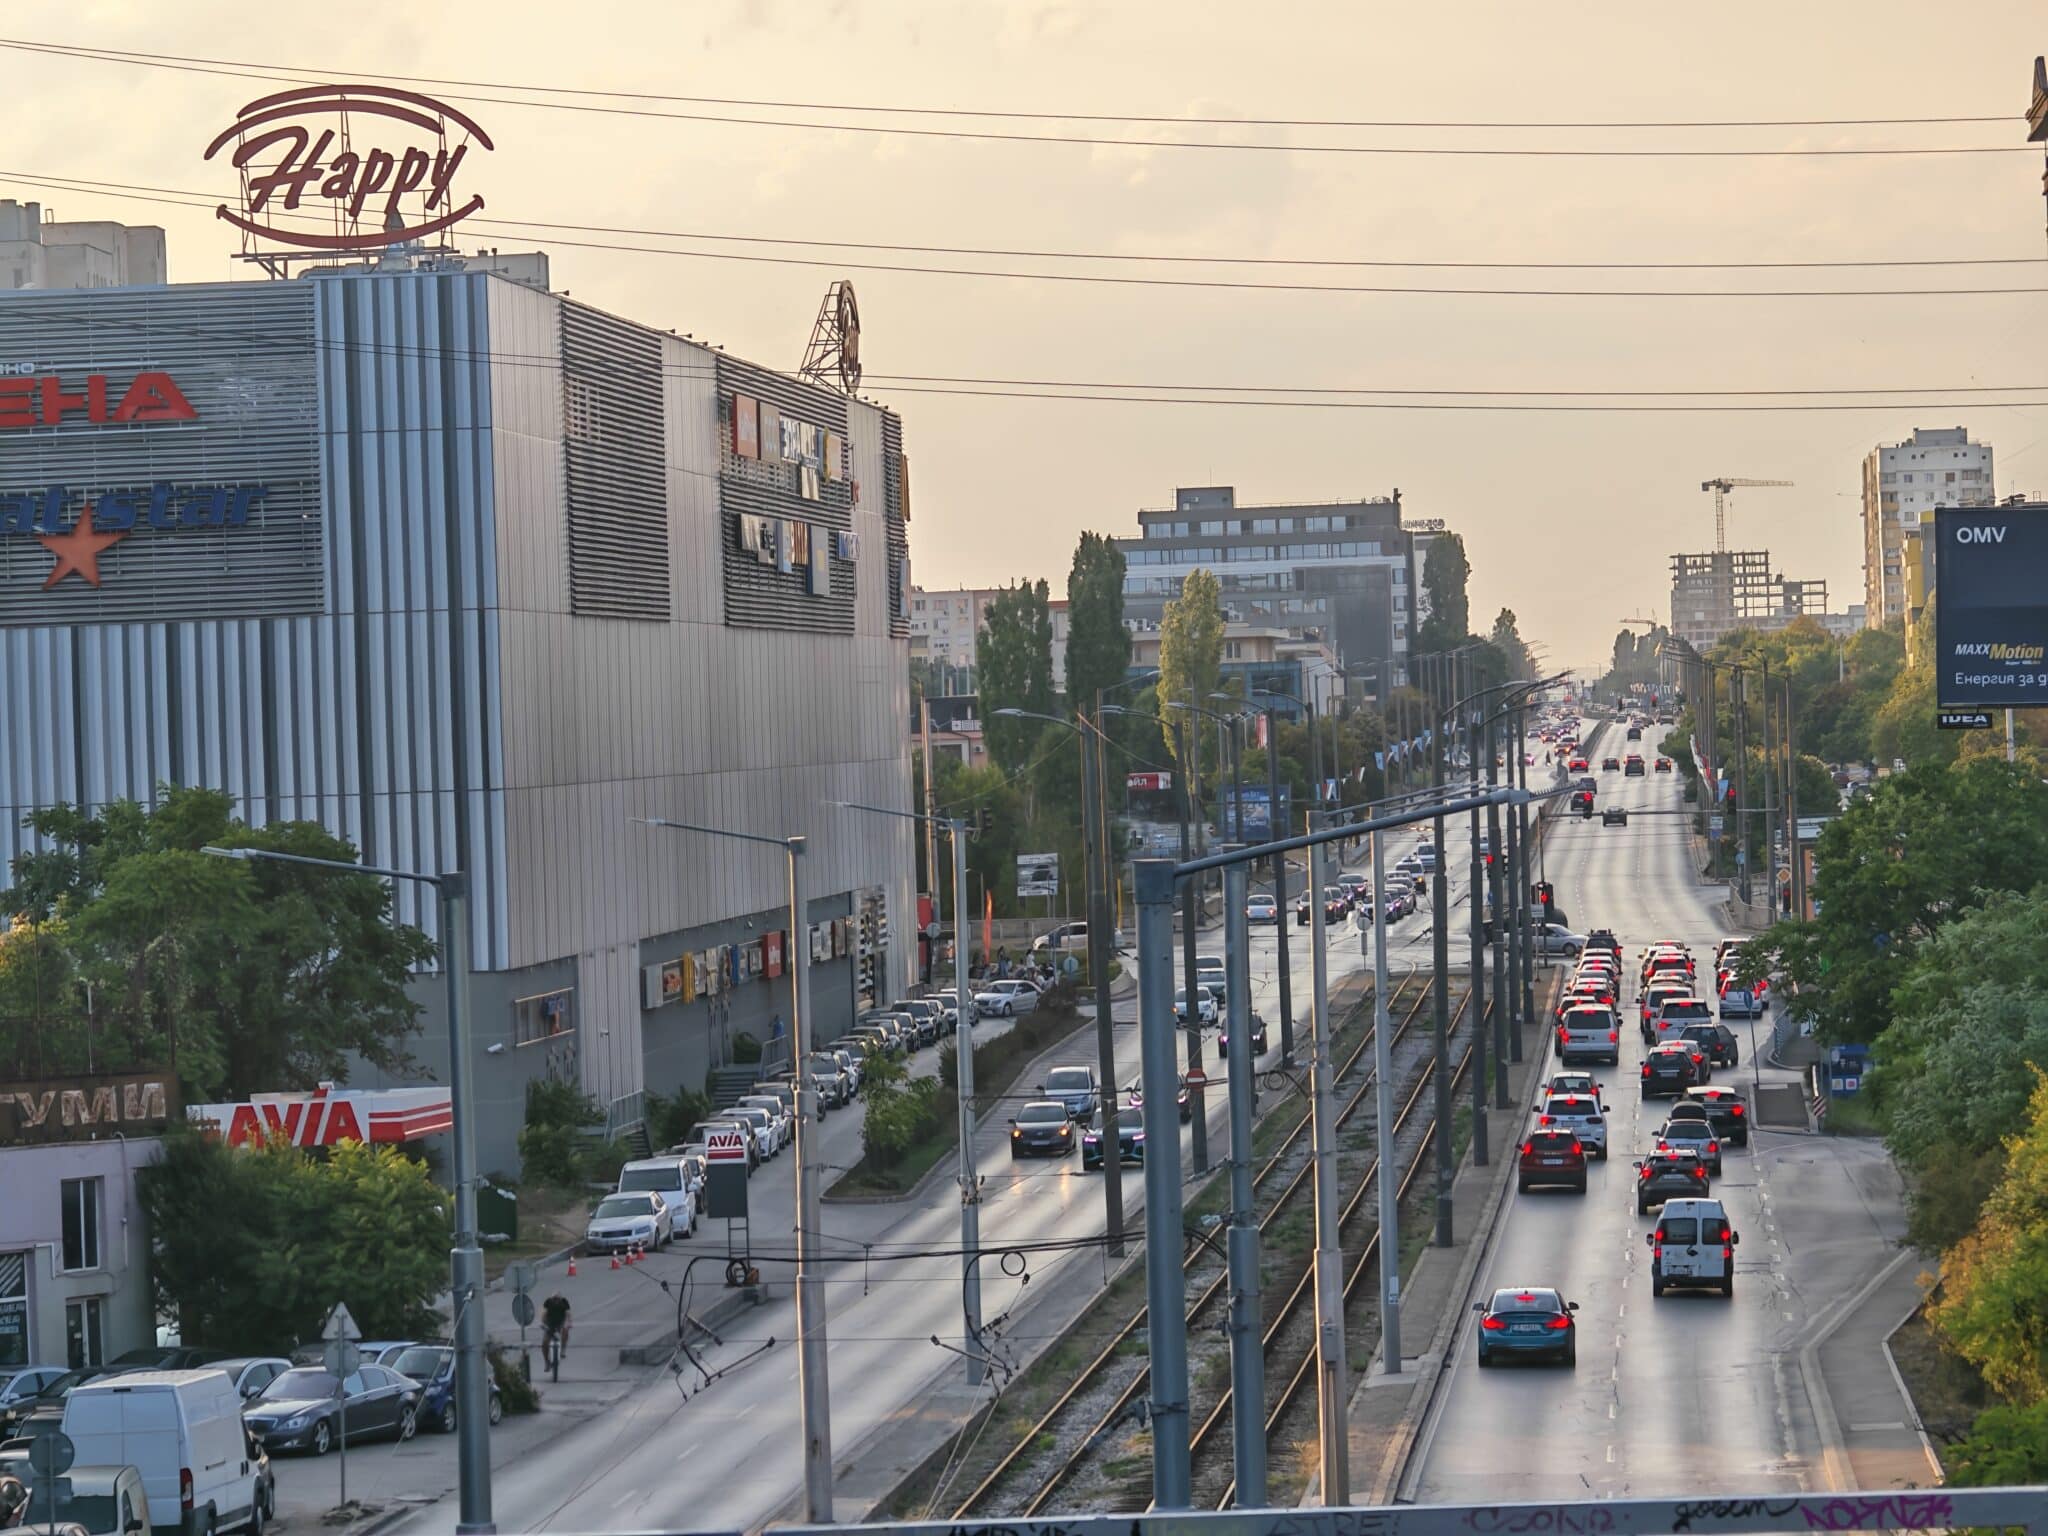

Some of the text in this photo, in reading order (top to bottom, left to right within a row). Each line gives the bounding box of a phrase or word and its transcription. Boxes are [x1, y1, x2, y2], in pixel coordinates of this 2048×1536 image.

[232, 125, 468, 218] Happy
[96, 481, 268, 532] star
[1956, 527, 2006, 544] OMV
[1955, 672, 2014, 687] Енергия
[2019, 674, 2034, 687] за
[1942, 715, 1988, 724] IDEA
[227, 1088, 364, 1150] AVIA
[707, 1132, 743, 1148] AVIA
